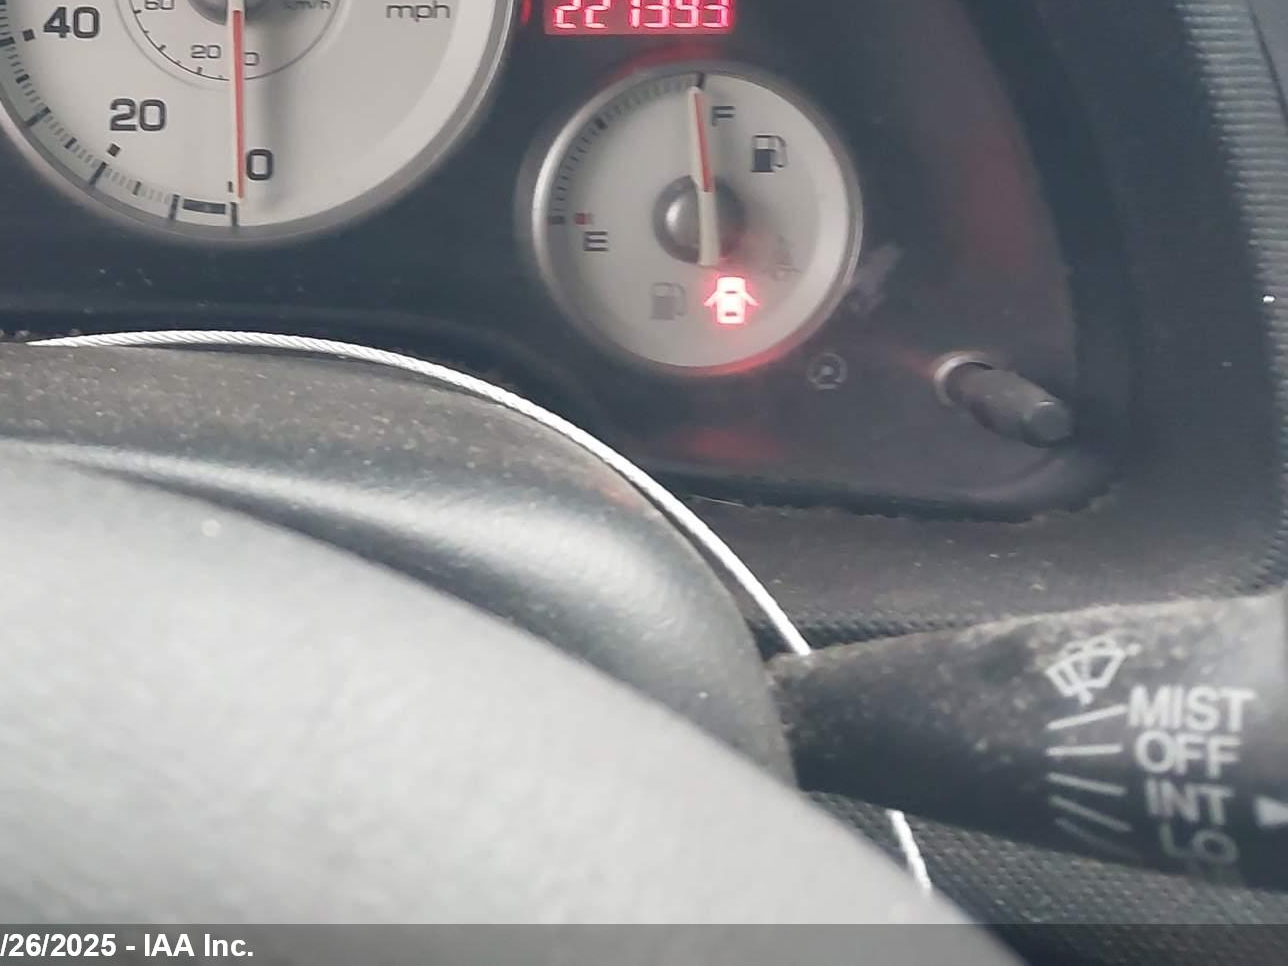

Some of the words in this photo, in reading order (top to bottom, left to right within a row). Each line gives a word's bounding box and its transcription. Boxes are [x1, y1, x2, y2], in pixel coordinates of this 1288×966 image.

[44, 6, 100, 39] 40
[386, 0, 450, 22] mph
[191, 44, 221, 60] 20
[110, 98, 165, 132] 20
[711, 105, 736, 126] F
[245, 149, 273, 180] 0
[583, 231, 608, 252] E
[1127, 684, 1257, 732] MIST
[1134, 730, 1241, 778] OFF
[1145, 778, 1234, 825] INT
